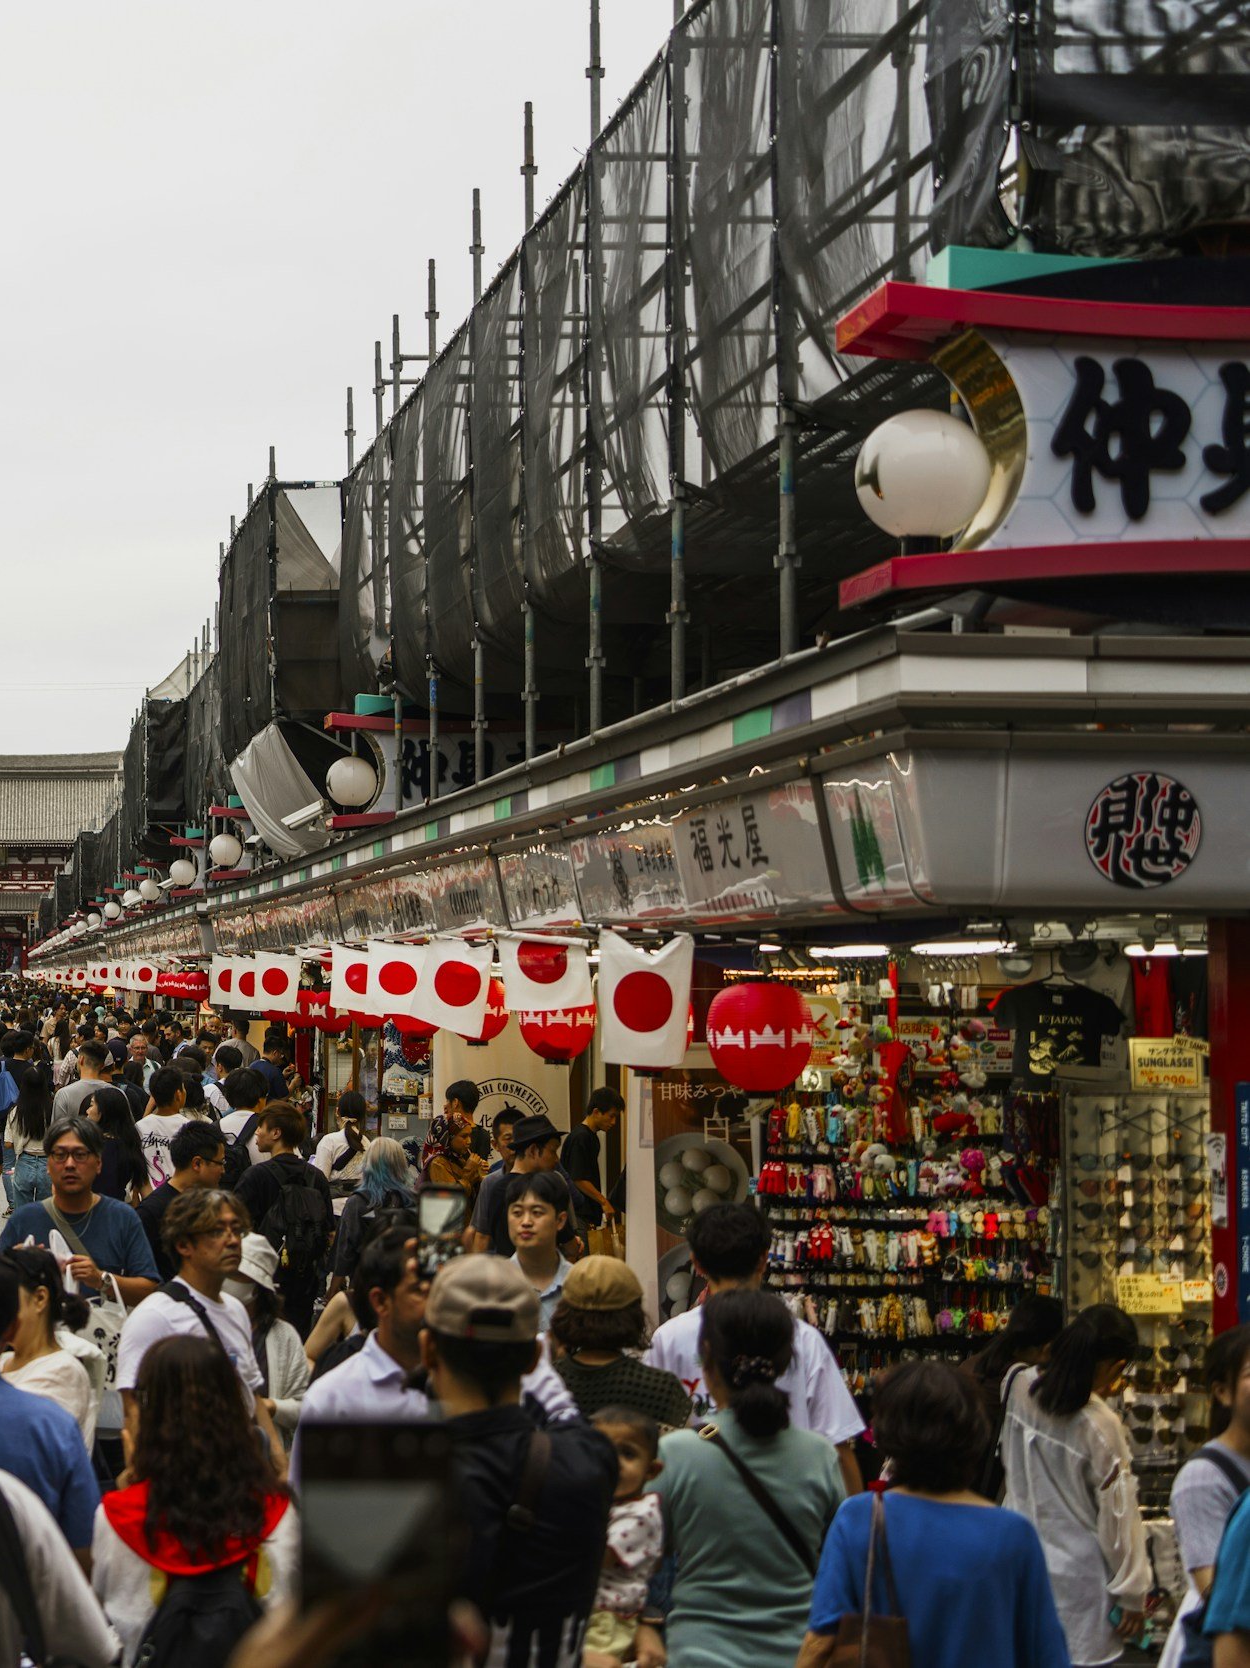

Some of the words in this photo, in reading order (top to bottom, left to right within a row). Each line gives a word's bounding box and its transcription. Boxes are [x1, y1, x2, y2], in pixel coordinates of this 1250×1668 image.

[689, 804, 770, 875] 福光屋
[1148, 1048, 1184, 1056] サングラス
[497, 1082, 544, 1114] COSMETICS
[1240, 1101, 1248, 1124] TAITO
[1240, 1127, 1248, 1146] CITY
[1240, 1168, 1249, 1209] ASAKUSA
